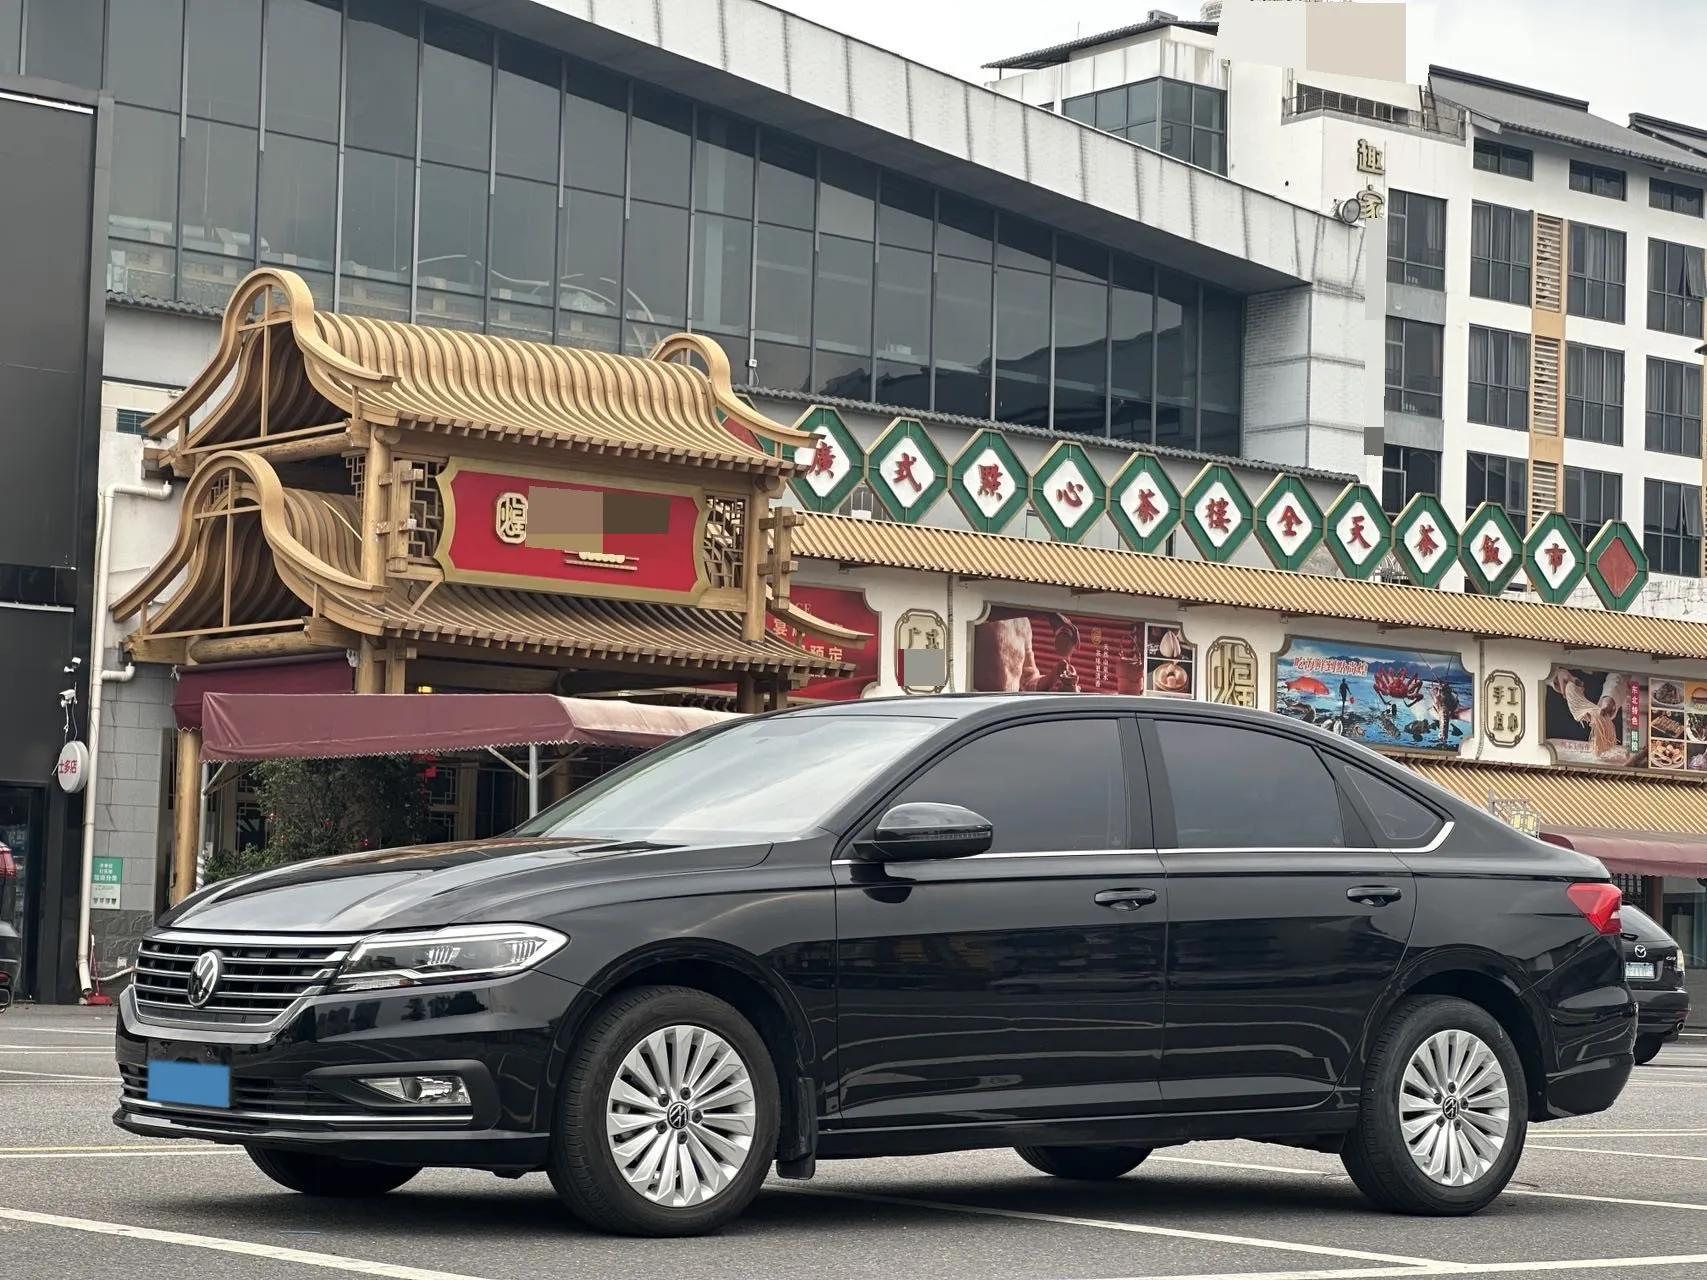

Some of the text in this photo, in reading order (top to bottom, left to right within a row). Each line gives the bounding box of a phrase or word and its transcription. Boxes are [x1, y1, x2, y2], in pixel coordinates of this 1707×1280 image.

[802, 645, 843, 662] 预定
[58, 759, 78, 774] 士多店
